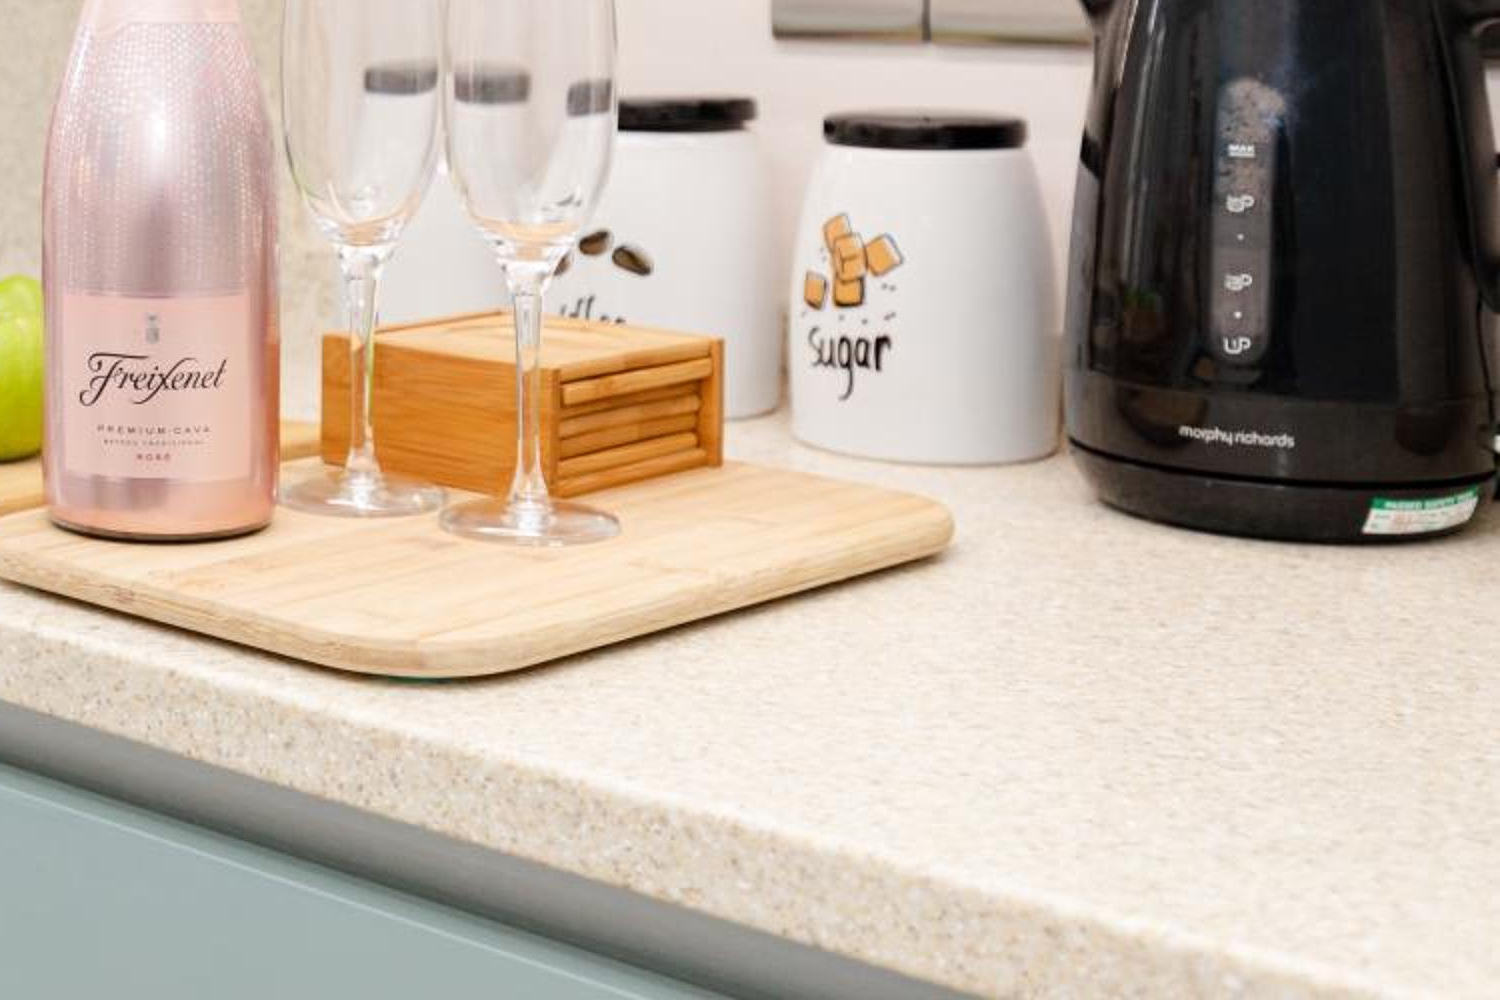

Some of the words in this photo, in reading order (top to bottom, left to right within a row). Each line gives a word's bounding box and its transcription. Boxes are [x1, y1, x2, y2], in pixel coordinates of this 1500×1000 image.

[79, 352, 228, 406] Freixenet
[808, 325, 892, 400] Sugar
[1178, 425, 1233, 447] morphy
[1235, 429, 1296, 449] richards
